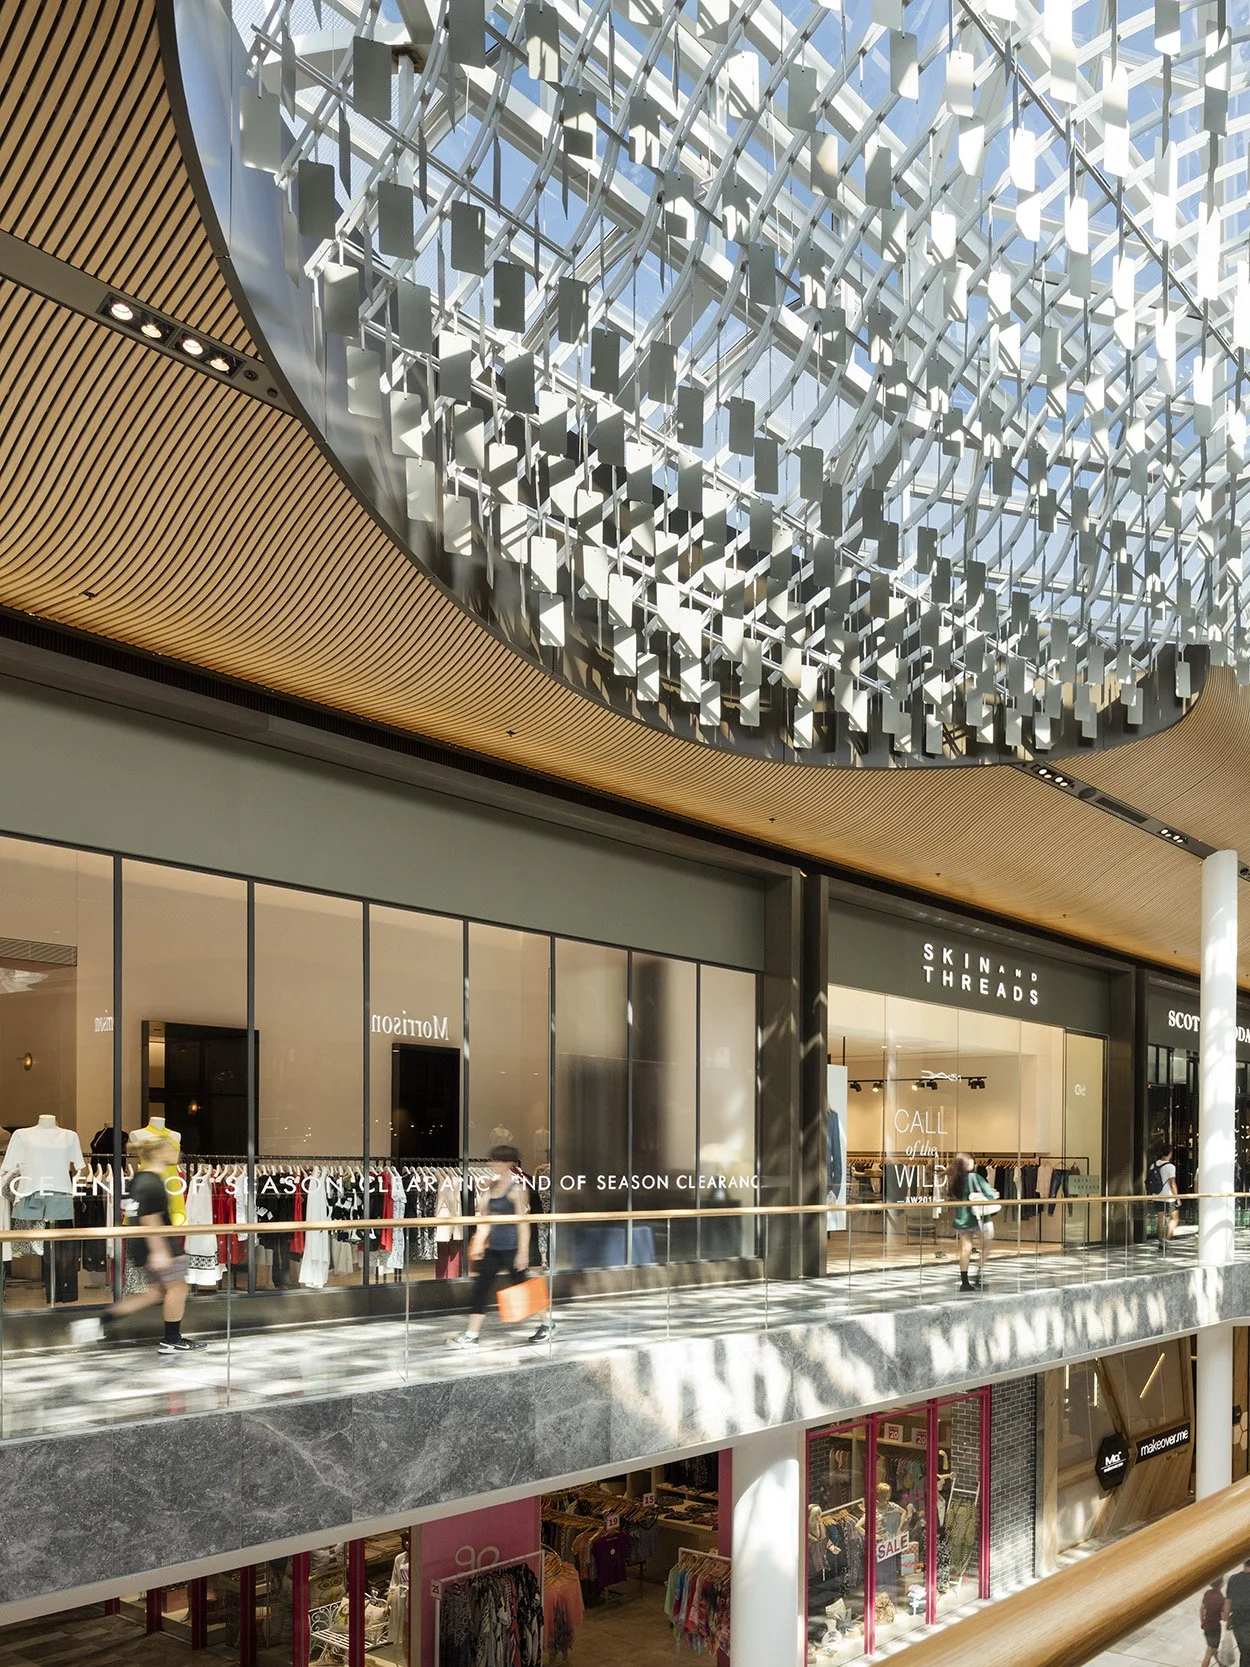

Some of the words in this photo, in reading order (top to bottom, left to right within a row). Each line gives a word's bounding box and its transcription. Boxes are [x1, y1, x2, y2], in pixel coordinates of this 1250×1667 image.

[923, 943, 990, 974] SKIN
[998, 965, 1038, 982] AND
[923, 965, 1039, 1006] THREADS
[1168, 1009, 1200, 1032] SCOT
[894, 1108, 949, 1134] CALL
[906, 1140, 920, 1160] of
[920, 1140, 938, 1157] the
[359, 1175, 490, 1194] CLEARANC
[560, 1174, 587, 1191] OF
[597, 1174, 669, 1191] SEASON
[894, 1164, 949, 1188] WILD
[608, 1517, 618, 1527] 19
[878, 1533, 908, 1559] SALE
[431, 1584, 440, 1594] 25
